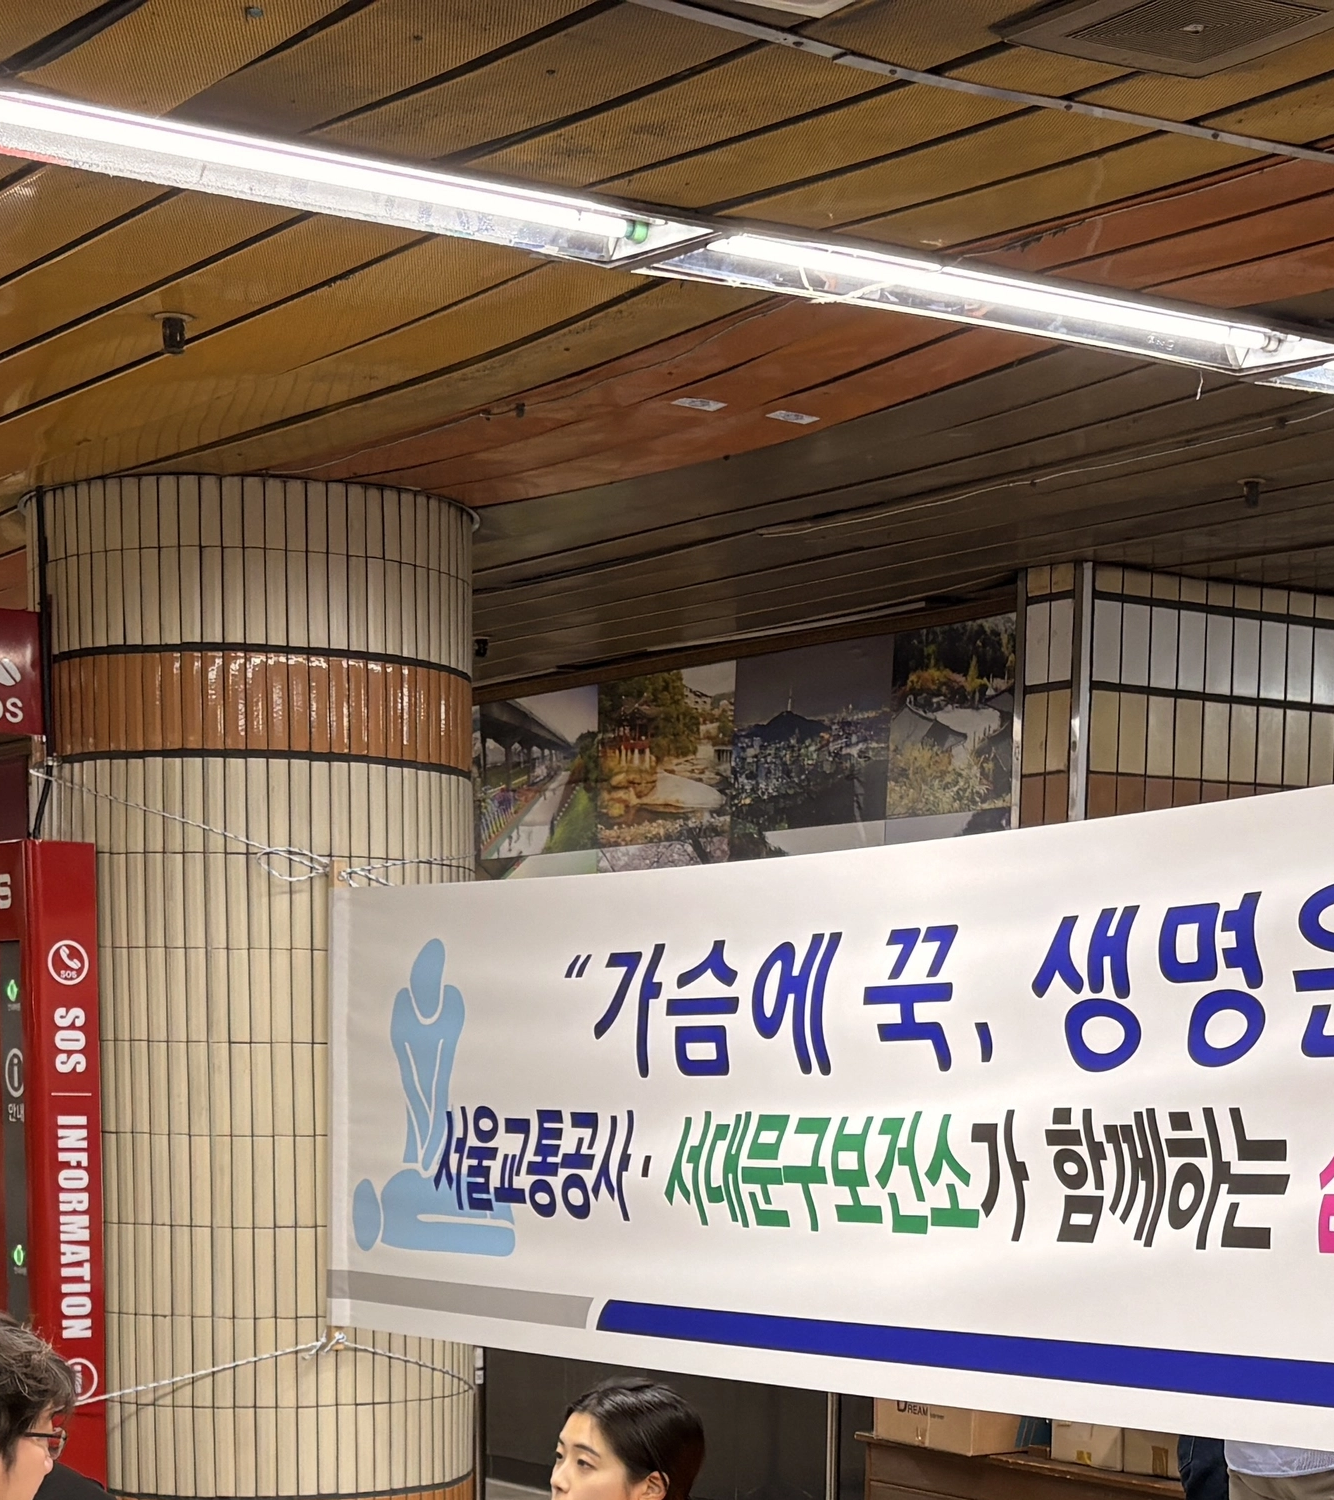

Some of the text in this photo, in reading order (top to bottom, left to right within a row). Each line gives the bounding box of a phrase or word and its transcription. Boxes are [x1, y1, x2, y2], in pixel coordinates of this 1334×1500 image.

[60, 971, 77, 979] SOS
[863, 924, 994, 1072] 꾹,
[54, 1007, 86, 1073] SOS
[8, 1103, 25, 1122] 안내
[57, 1115, 92, 1339] INFORMATION
[664, 1109, 1029, 1242] 서대문구보건소가
[1045, 1105, 1291, 1250] 함께하는
